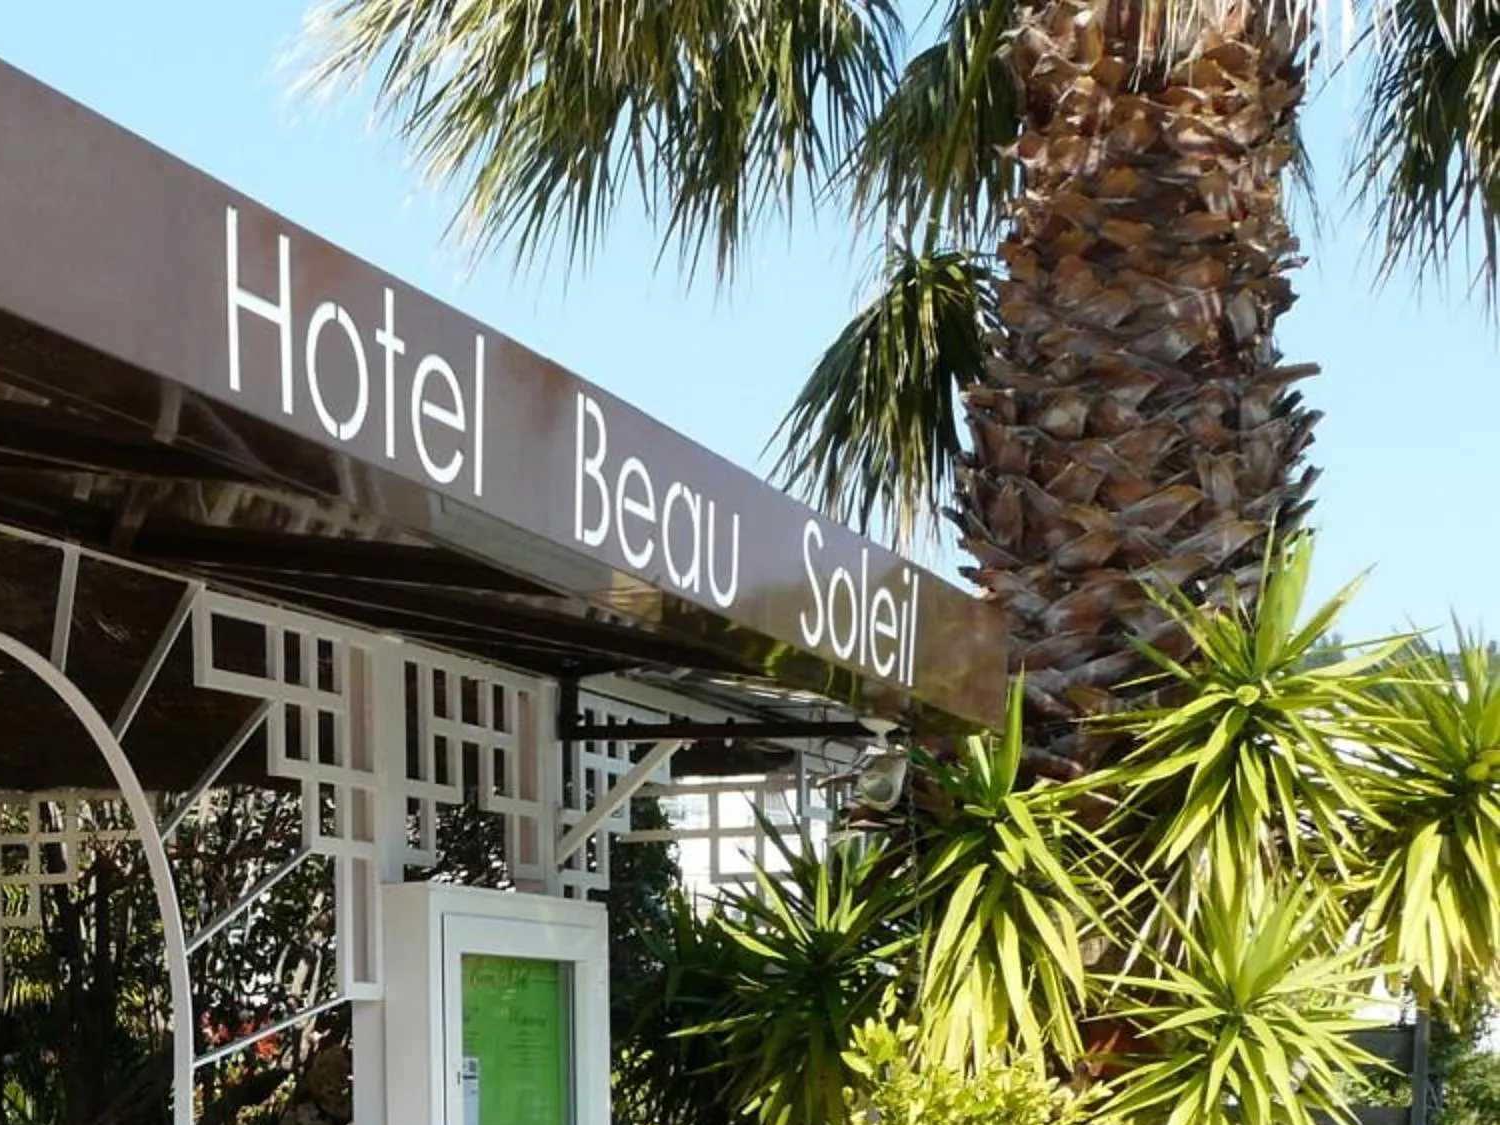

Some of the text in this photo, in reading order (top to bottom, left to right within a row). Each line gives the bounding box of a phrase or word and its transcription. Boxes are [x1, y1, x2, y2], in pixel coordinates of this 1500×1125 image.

[226, 206, 919, 687] Hotel Beau Soleil
